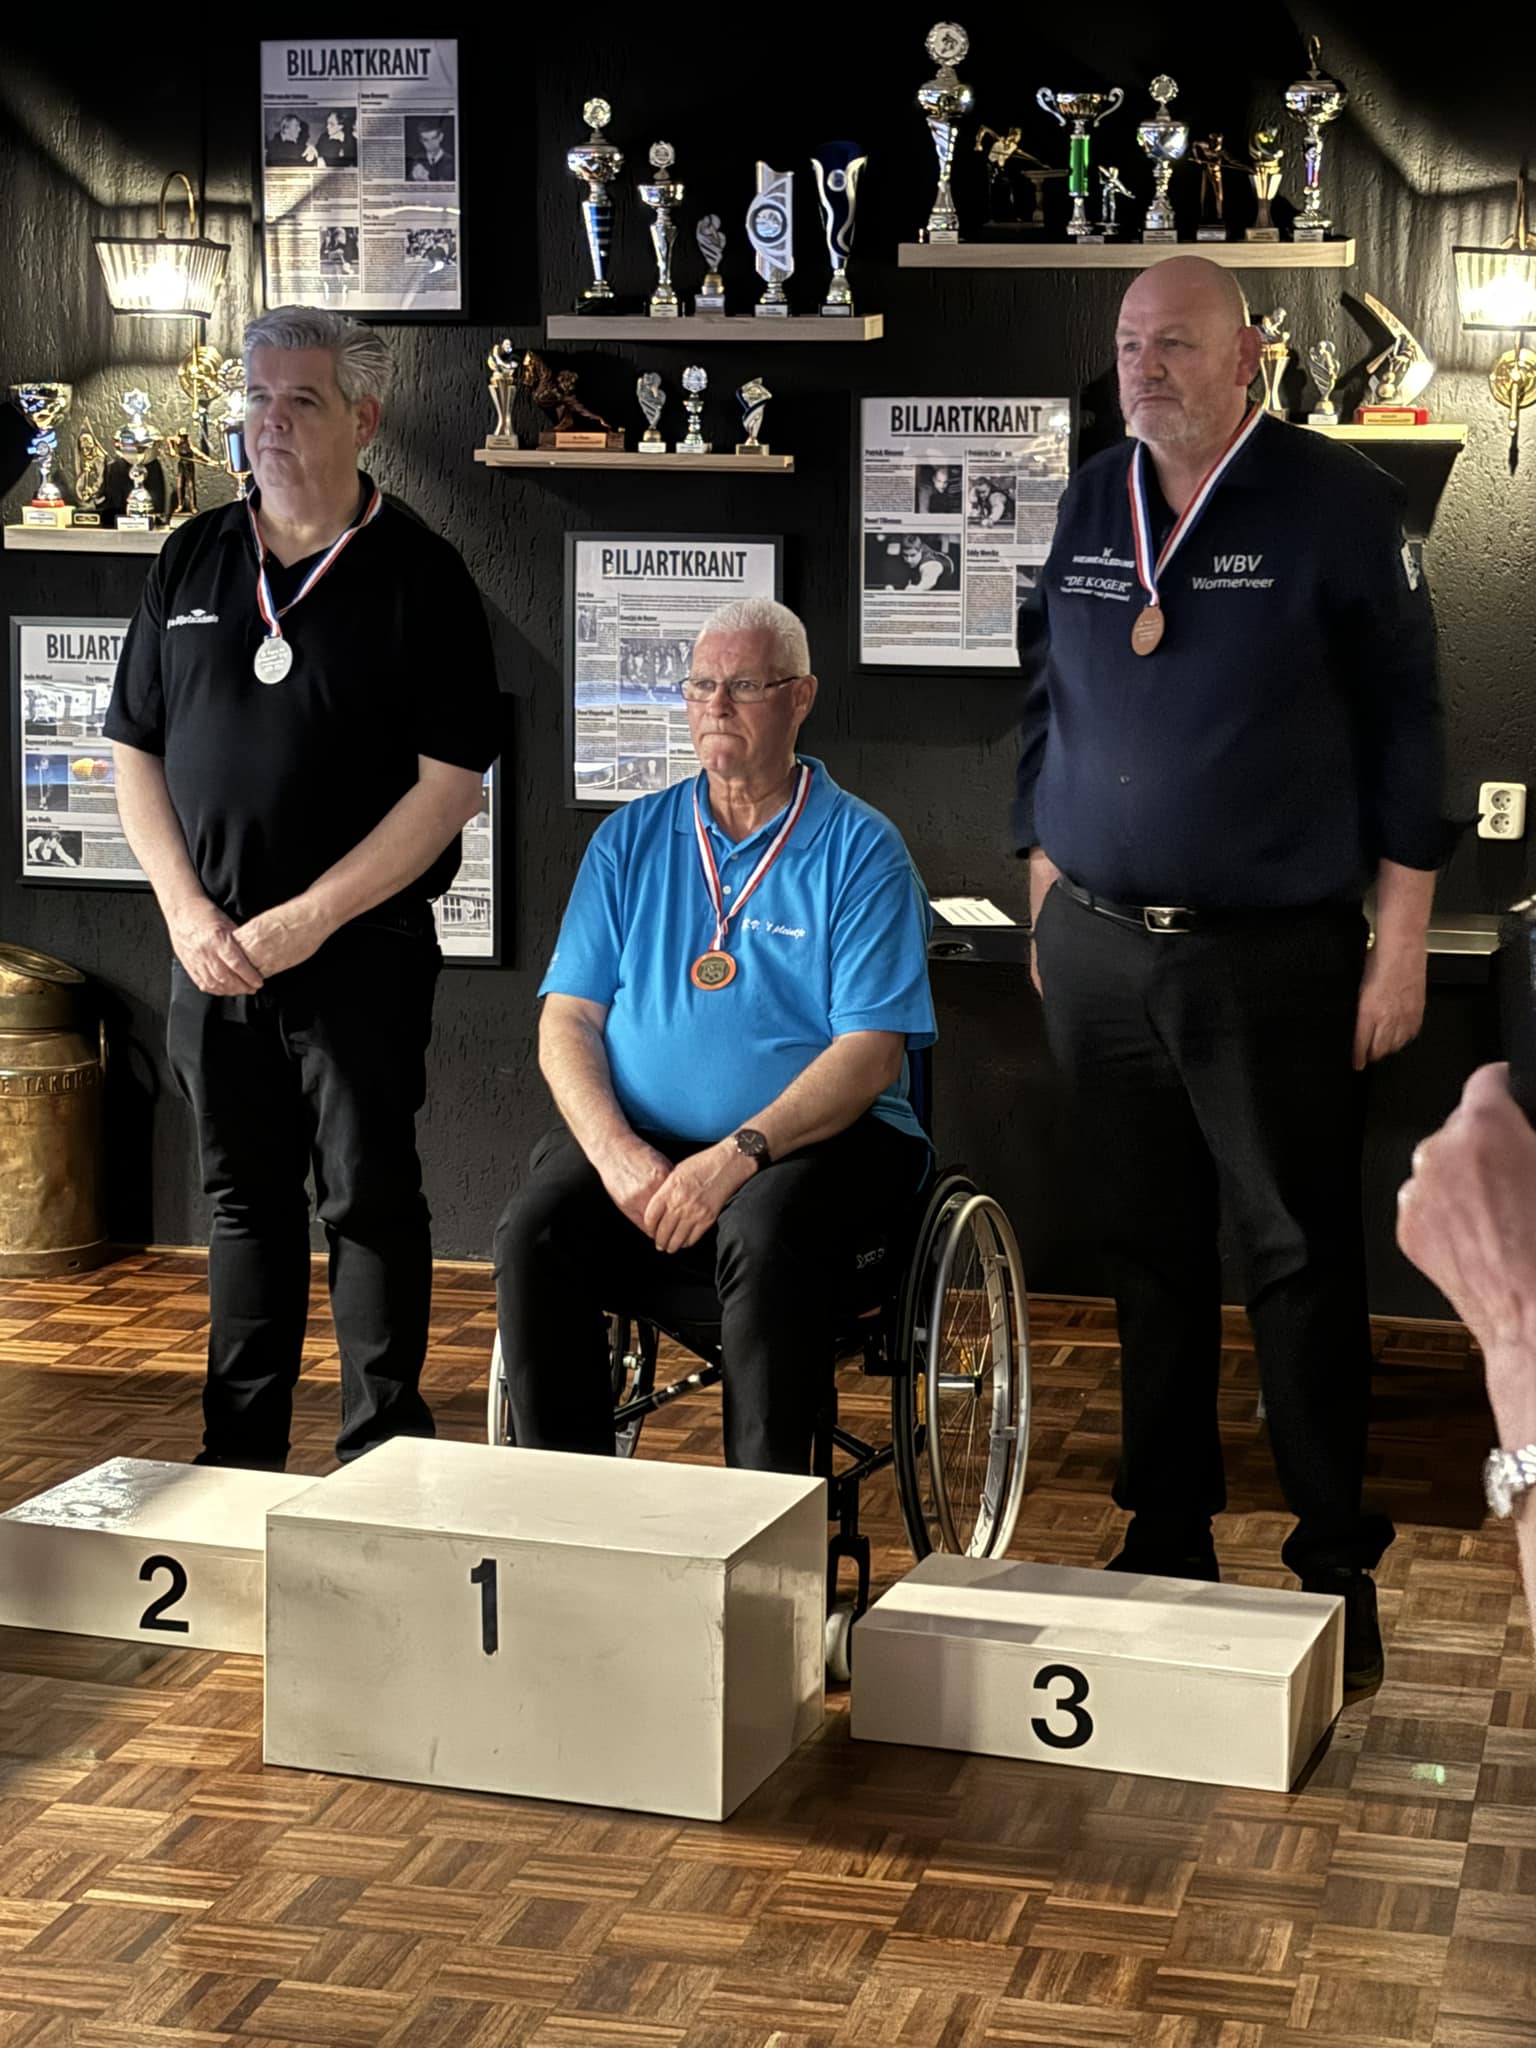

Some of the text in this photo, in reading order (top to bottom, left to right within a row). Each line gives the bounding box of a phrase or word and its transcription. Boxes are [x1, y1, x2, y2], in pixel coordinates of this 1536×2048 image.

[287, 48, 431, 76] BILJARTKRANT
[891, 405, 1042, 433] BILJARTKRANT
[602, 549, 747, 577] BILJARTKRANT
[1213, 554, 1263, 573] WBV
[1192, 577, 1275, 590] Wormerveer
[46, 634, 125, 661] BILJART
[138, 1554, 189, 1633] 2
[470, 1558, 498, 1656] 1
[1030, 1664, 1094, 1749] 3
